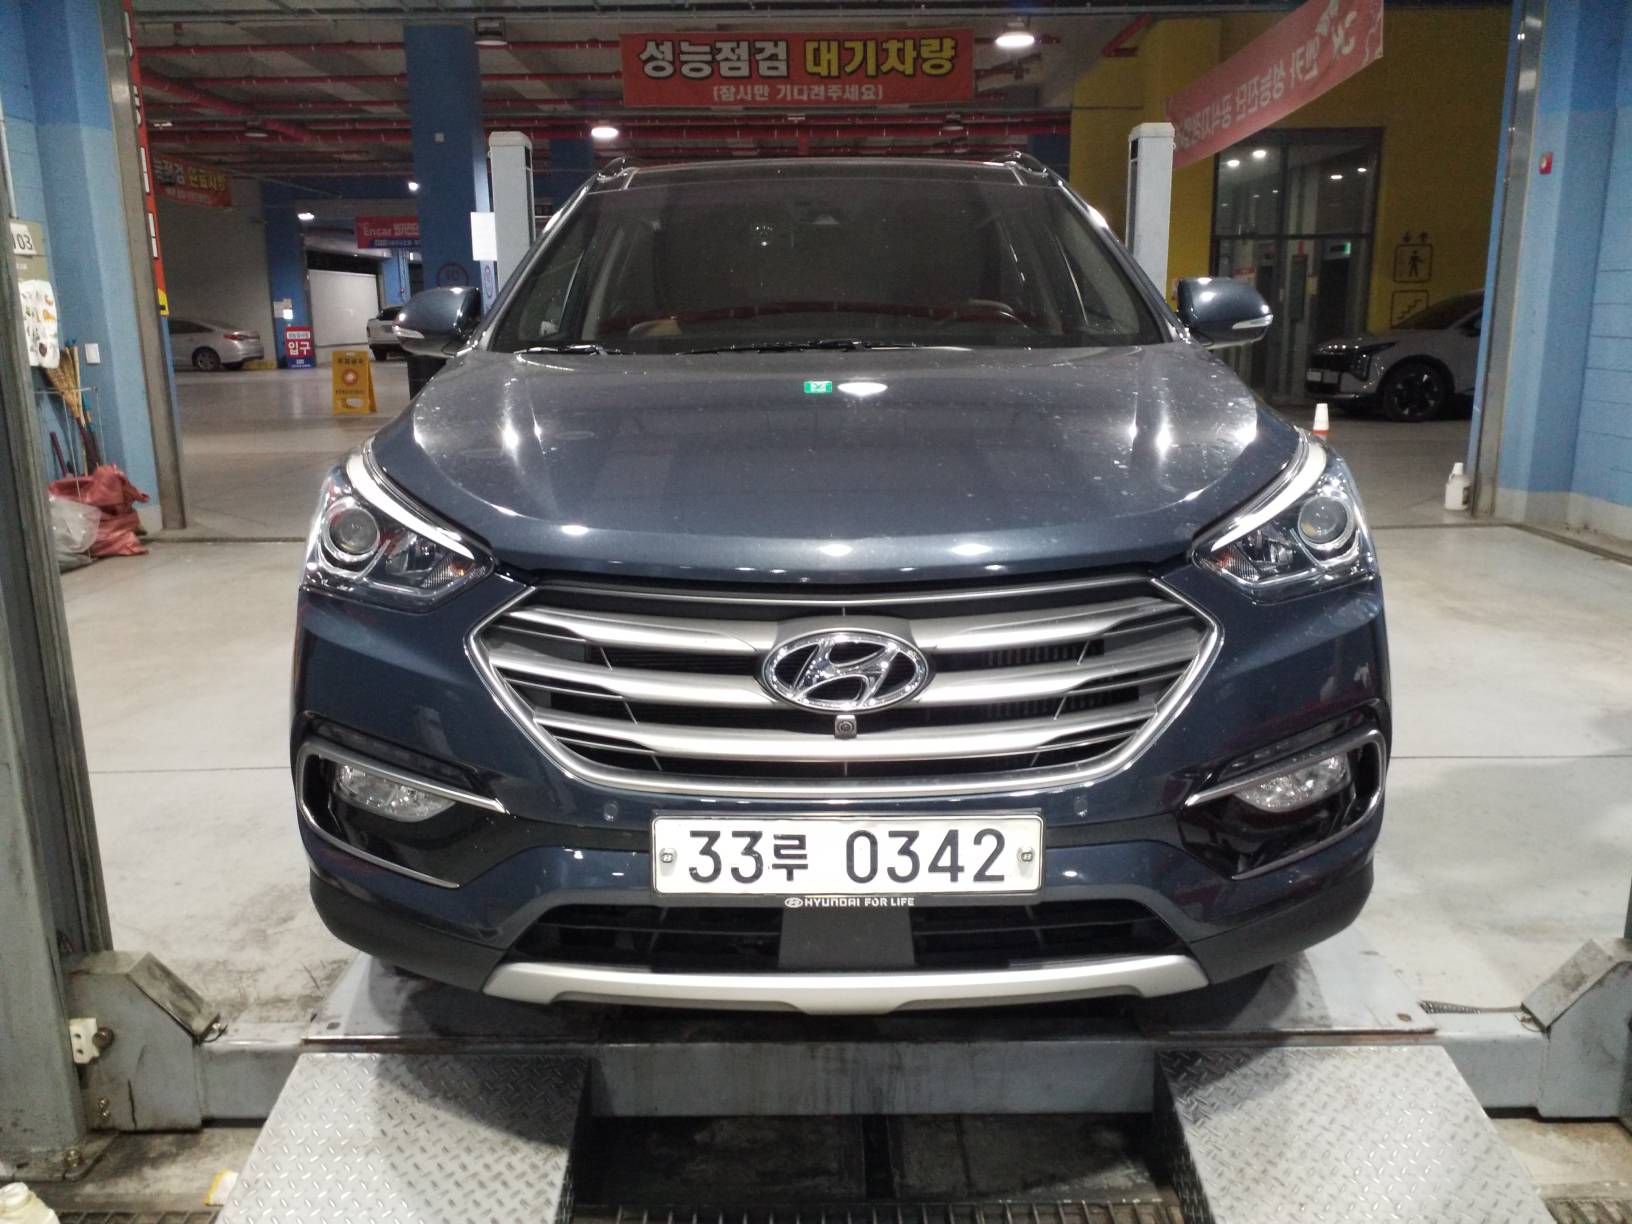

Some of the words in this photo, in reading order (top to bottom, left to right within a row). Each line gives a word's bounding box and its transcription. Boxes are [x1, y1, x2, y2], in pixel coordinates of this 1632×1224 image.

[639, 39, 790, 80] 성능점검
[803, 37, 957, 77] 대기차량
[713, 84, 769, 101] (잠시만
[778, 83, 884, 101] 기다려주세요)
[288, 341, 311, 355] 입구
[688, 830, 809, 883] 33루
[845, 828, 1006, 884] 0342
[804, 897, 860, 907] HYUNDAI
[864, 897, 888, 907] FOR
[890, 897, 915, 907] LIFE
